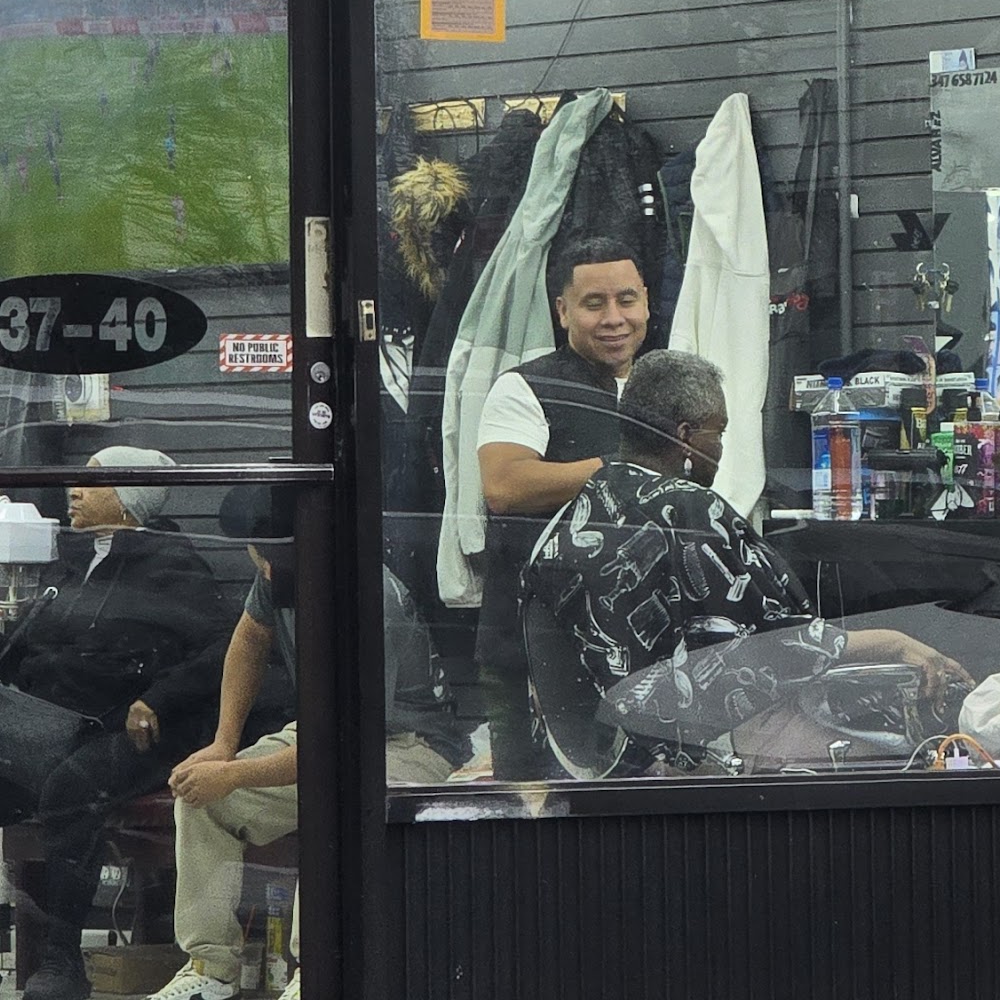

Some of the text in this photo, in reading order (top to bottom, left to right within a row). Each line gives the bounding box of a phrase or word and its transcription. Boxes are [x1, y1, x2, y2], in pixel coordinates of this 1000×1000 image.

[232, 342, 279, 353] NO PUBLIC
[228, 353, 284, 364] RESTROOMS
[854, 376, 880, 385] BLACK
